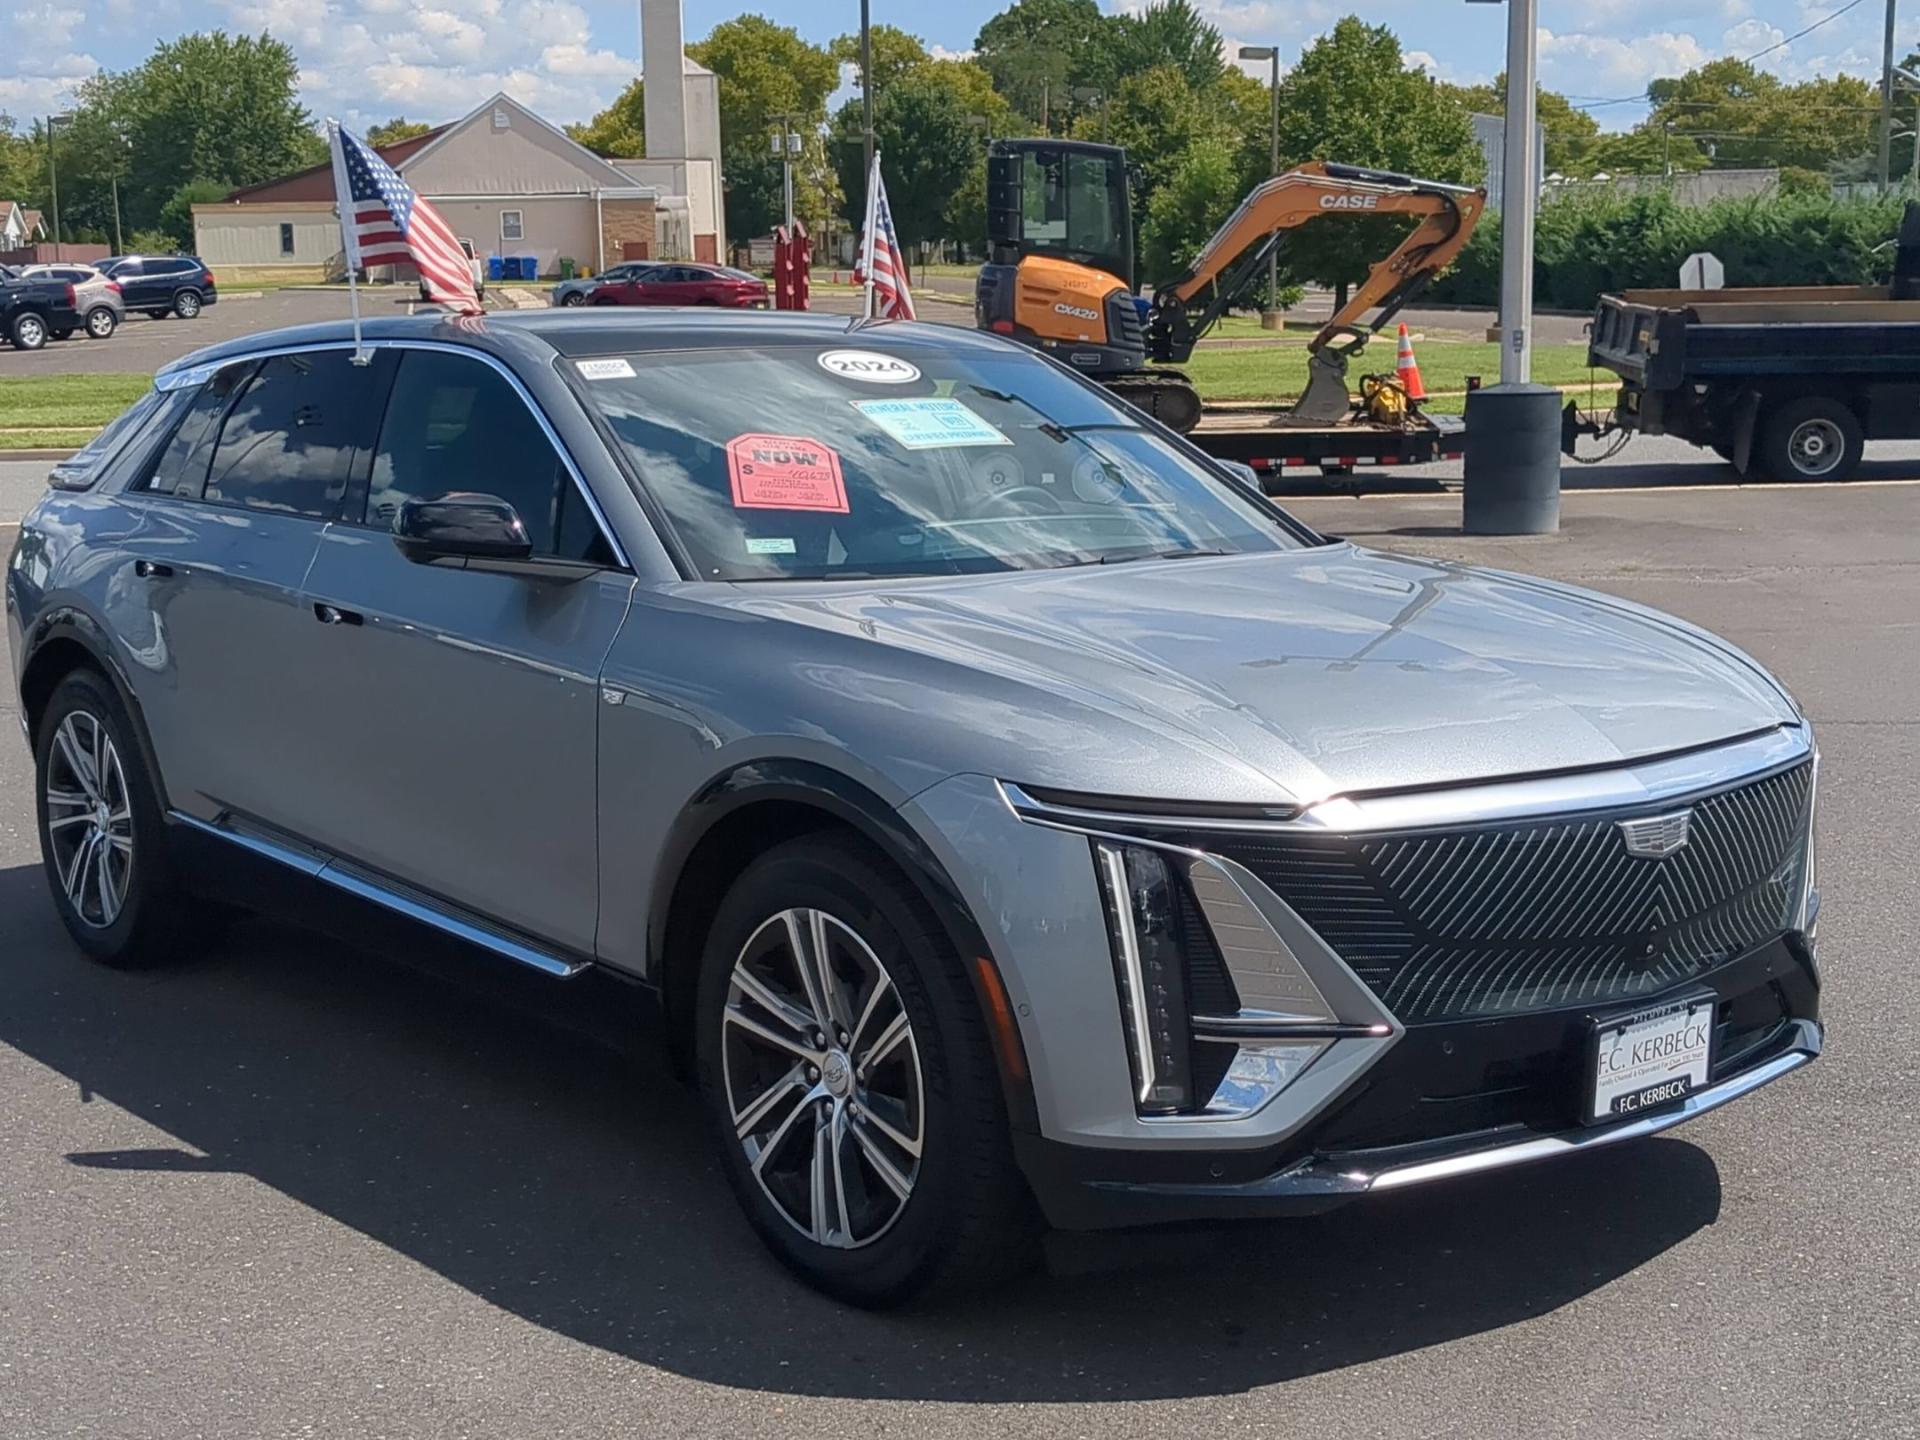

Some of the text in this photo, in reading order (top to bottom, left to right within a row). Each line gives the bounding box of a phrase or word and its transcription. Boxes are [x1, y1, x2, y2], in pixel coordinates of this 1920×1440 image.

[1319, 194, 1378, 209] CASE
[832, 359, 908, 373] 2024
[861, 401, 965, 415] GENERAL MOTORS
[751, 449, 819, 466] NOW
[1598, 1047, 1625, 1075] F.C.
[1631, 1023, 1708, 1065] KERBECK
[1620, 1079, 1686, 1113] F.C. KERBECK
